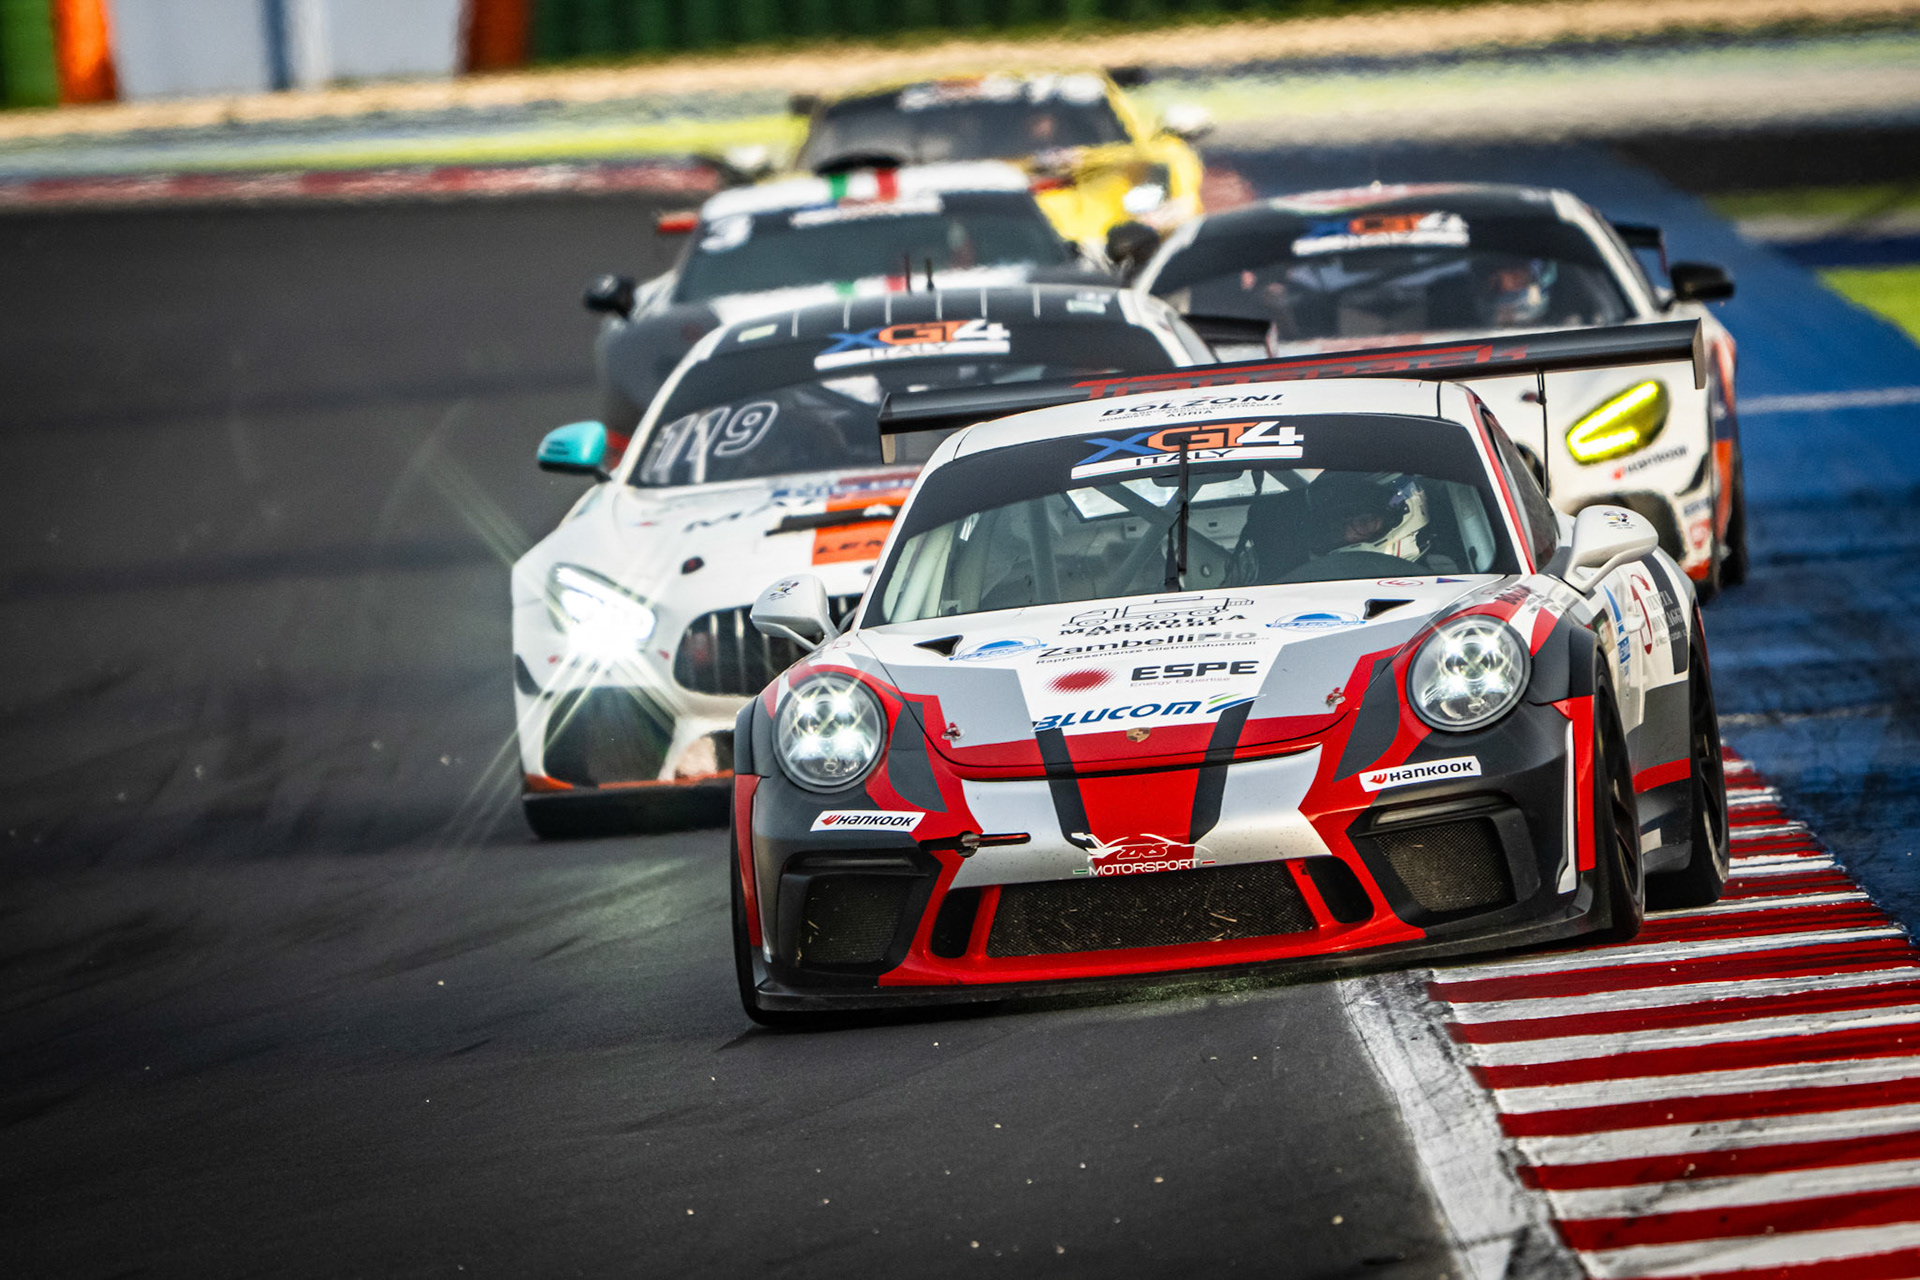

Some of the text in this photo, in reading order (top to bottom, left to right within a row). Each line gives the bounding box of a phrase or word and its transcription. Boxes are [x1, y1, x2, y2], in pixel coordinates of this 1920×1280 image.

[820, 318, 1011, 354] XGT4
[1102, 394, 1284, 417] BOLZONI
[1166, 409, 1213, 418] ADRIA
[1076, 421, 1304, 466] XGT4
[1135, 449, 1236, 466] ITALY
[1058, 614, 1248, 635] MARZOLLA
[1131, 660, 1260, 682] ESPE
[1129, 676, 1231, 689] Energy Expertise
[1034, 700, 1202, 731] BLUCOM
[1088, 858, 1200, 876] MOTORSPORT
